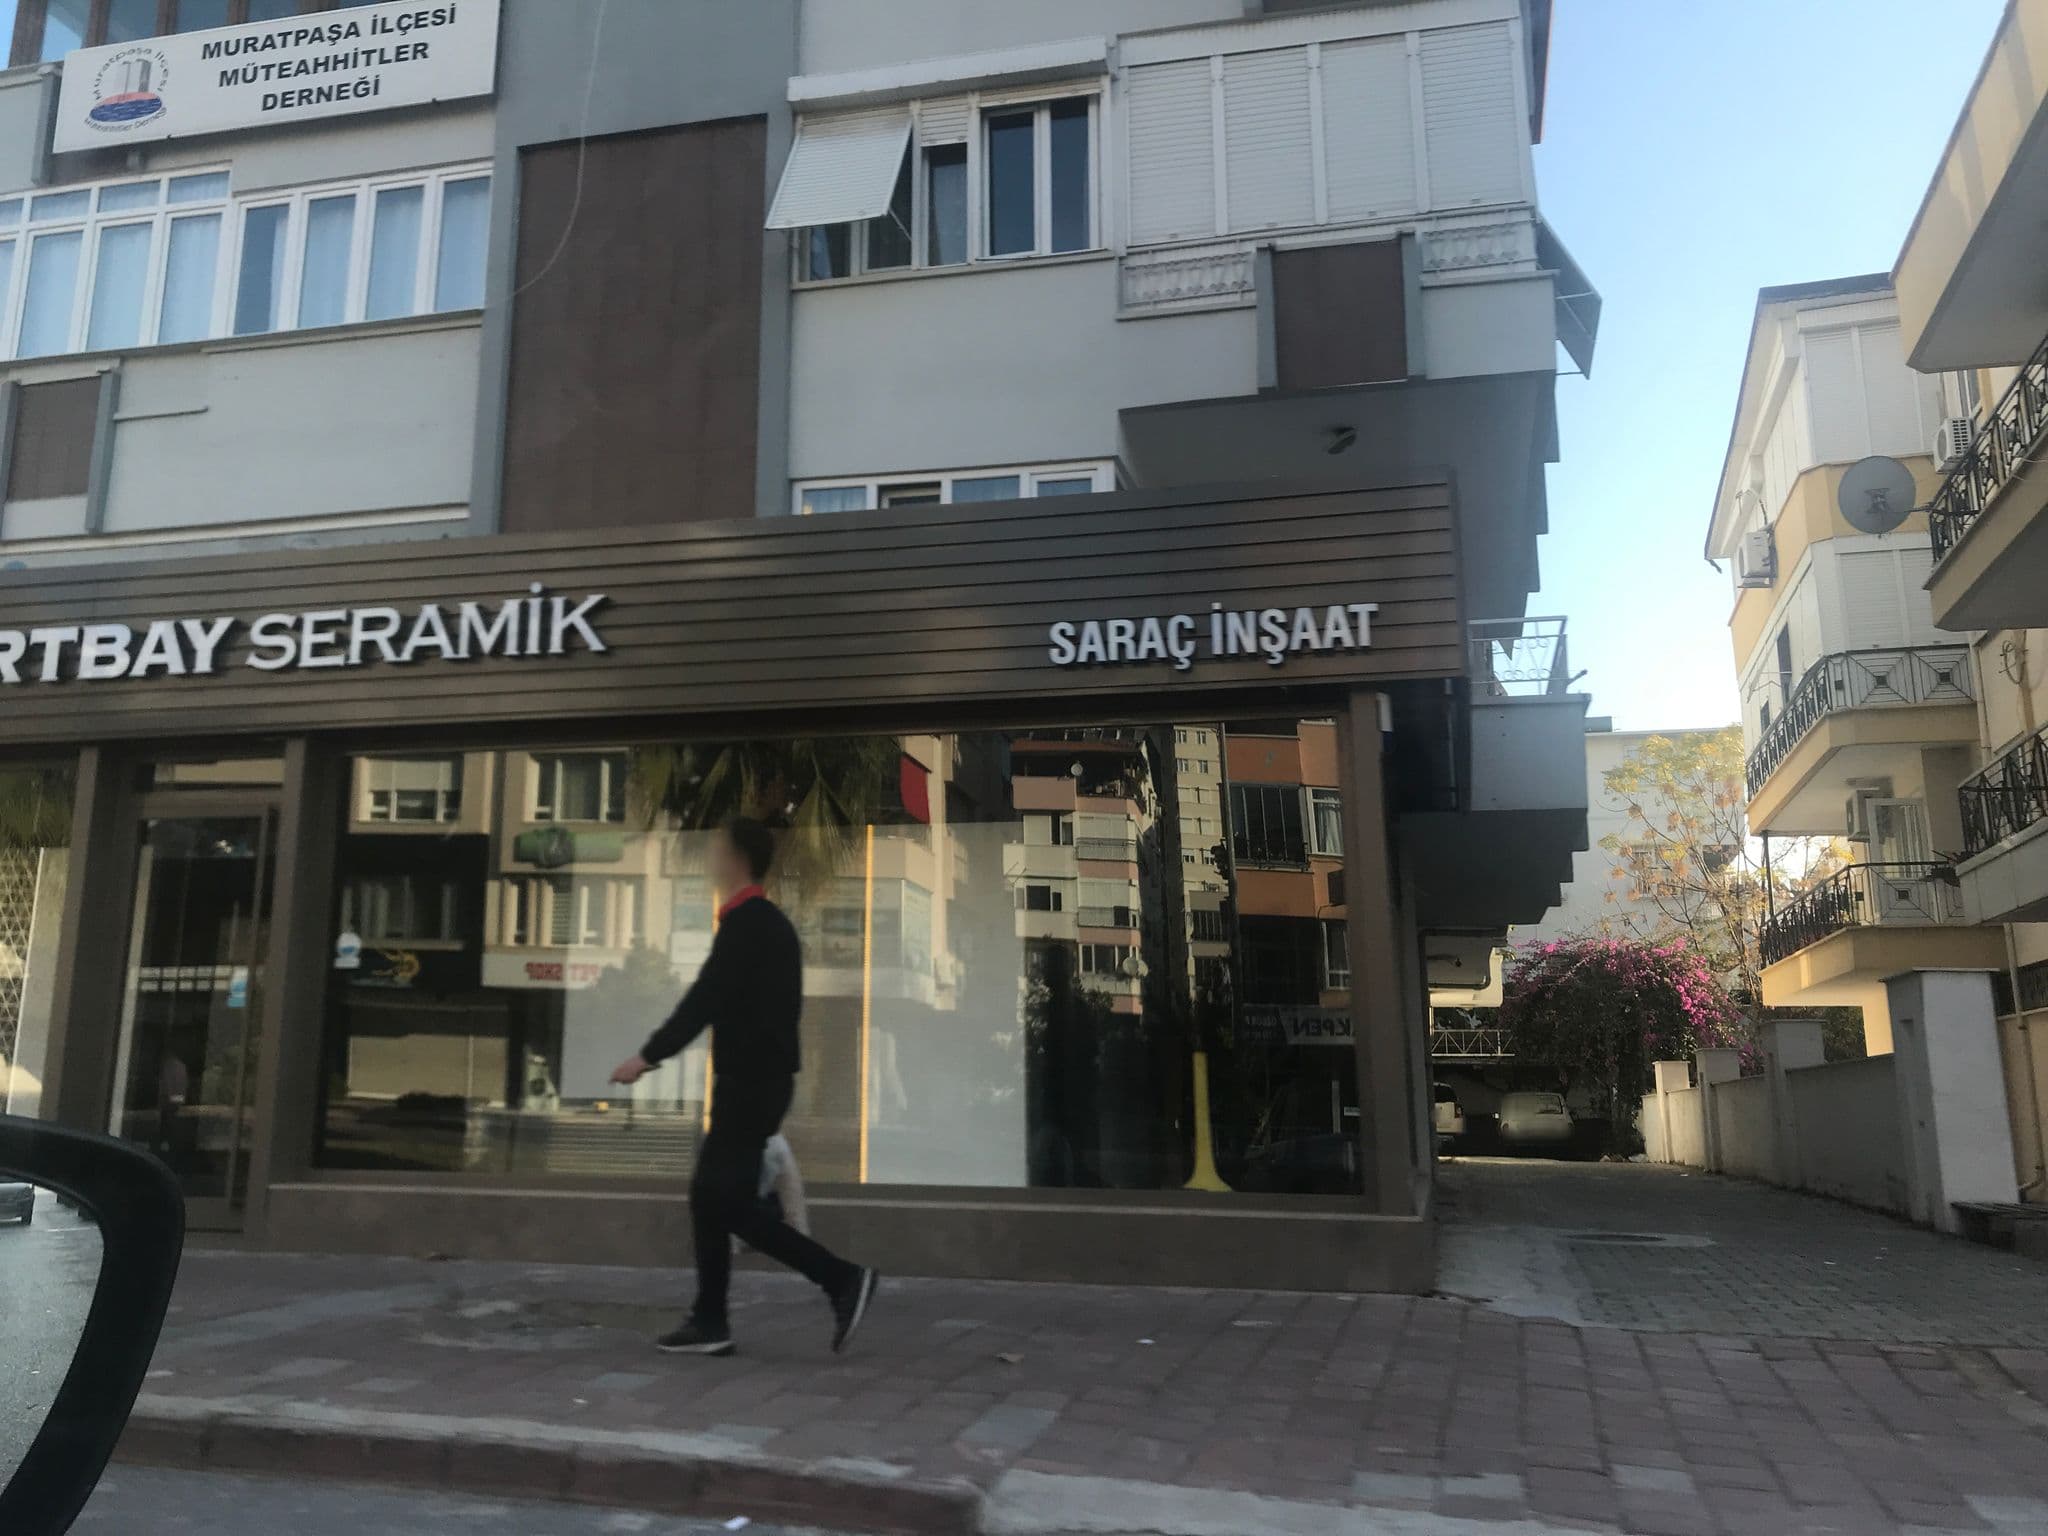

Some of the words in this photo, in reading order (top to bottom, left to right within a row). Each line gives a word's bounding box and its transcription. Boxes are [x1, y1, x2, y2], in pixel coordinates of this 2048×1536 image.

[201, 21, 361, 60] MURATPAŞA
[370, 3, 457, 36] İLÇESİ
[218, 42, 429, 87] MÜTEAHHİTLER
[261, 75, 381, 111] DERNEĞİ
[246, 581, 607, 670] SERAMİK
[1049, 614, 1196, 670] SARAÇ
[1210, 602, 1379, 665] İNŞAAT
